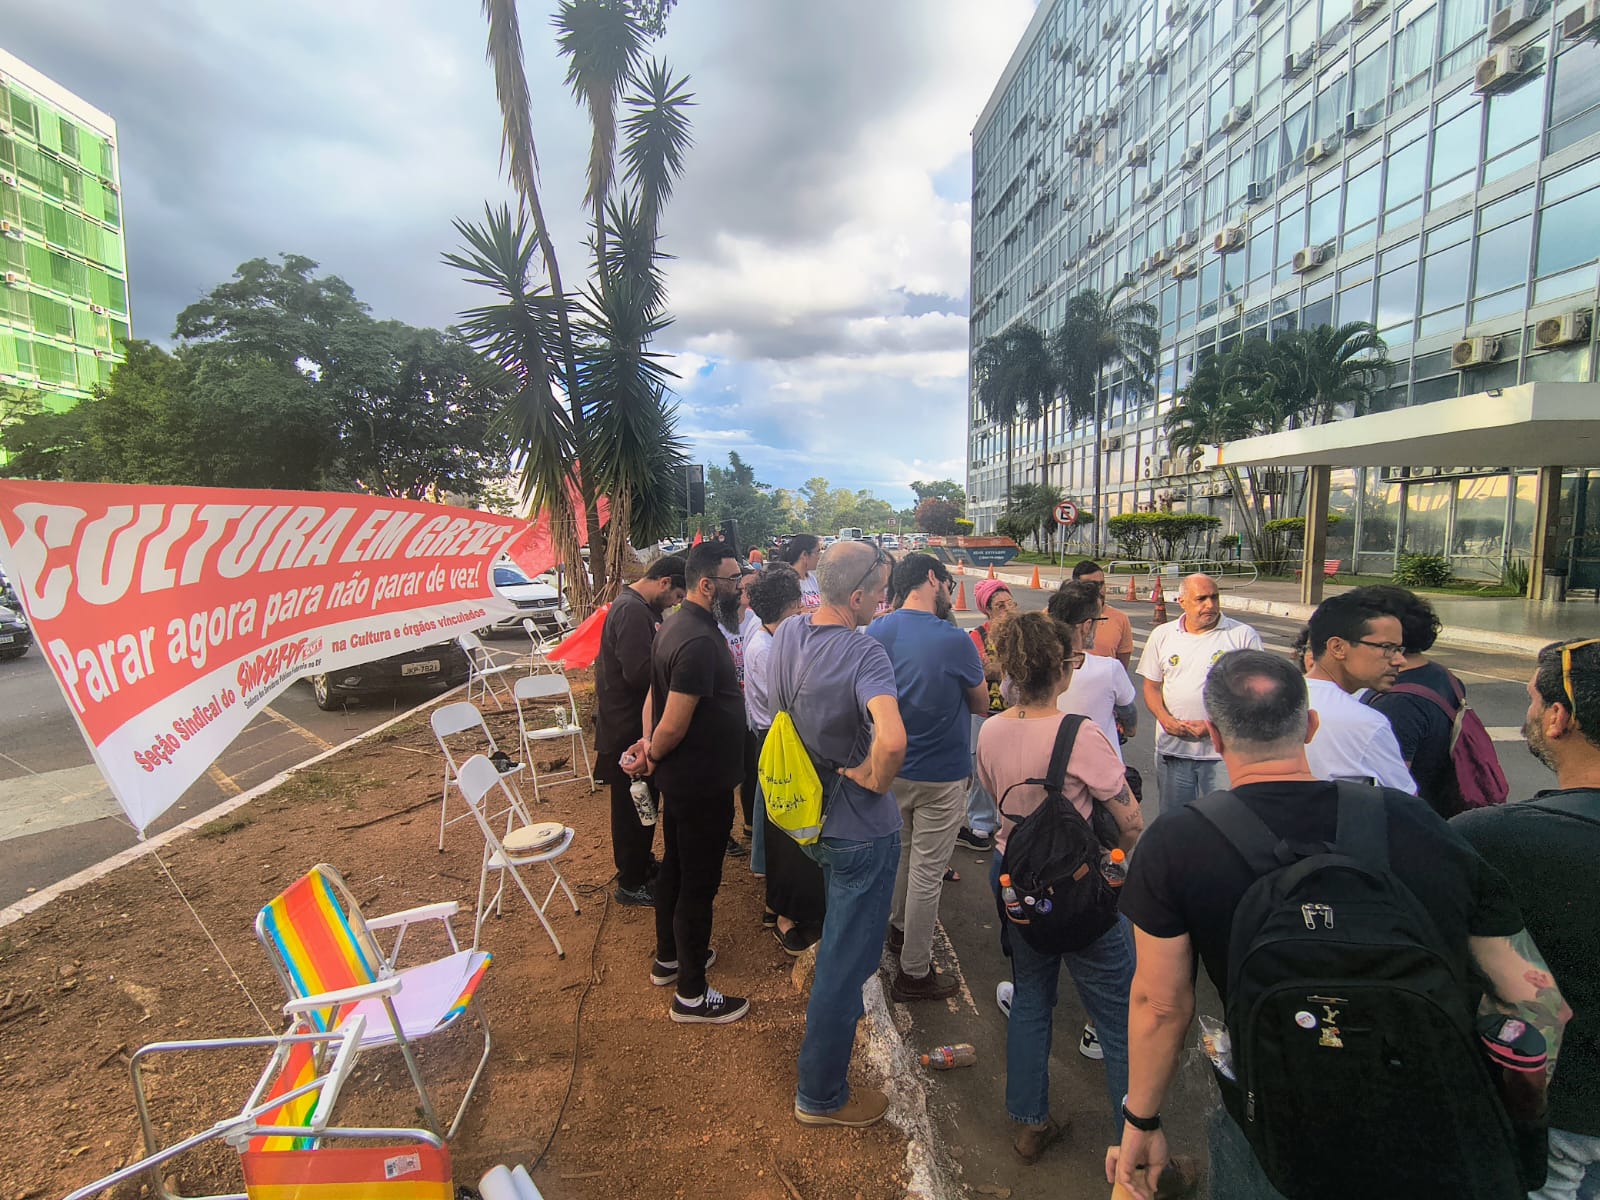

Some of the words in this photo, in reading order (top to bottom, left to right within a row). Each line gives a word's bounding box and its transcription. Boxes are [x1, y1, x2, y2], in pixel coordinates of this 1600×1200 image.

[11, 502, 358, 620] CULTURA
[338, 509, 426, 563] EM
[404, 515, 514, 559] GREVE
[1060, 505, 1071, 520] E
[48, 626, 155, 713] Parar
[167, 598, 257, 669] agora
[261, 584, 324, 639] para
[326, 570, 370, 609] não
[371, 568, 425, 610] parar
[425, 562, 446, 594] de
[450, 561, 482, 590] vez!
[133, 734, 180, 772] Seção
[172, 694, 222, 741] Sindical
[221, 688, 236, 709] do
[332, 638, 347, 652] na
[350, 630, 391, 648] Cultura
[394, 628, 400, 638] e
[403, 619, 436, 637] órgãos
[437, 608, 486, 628] vinculados
